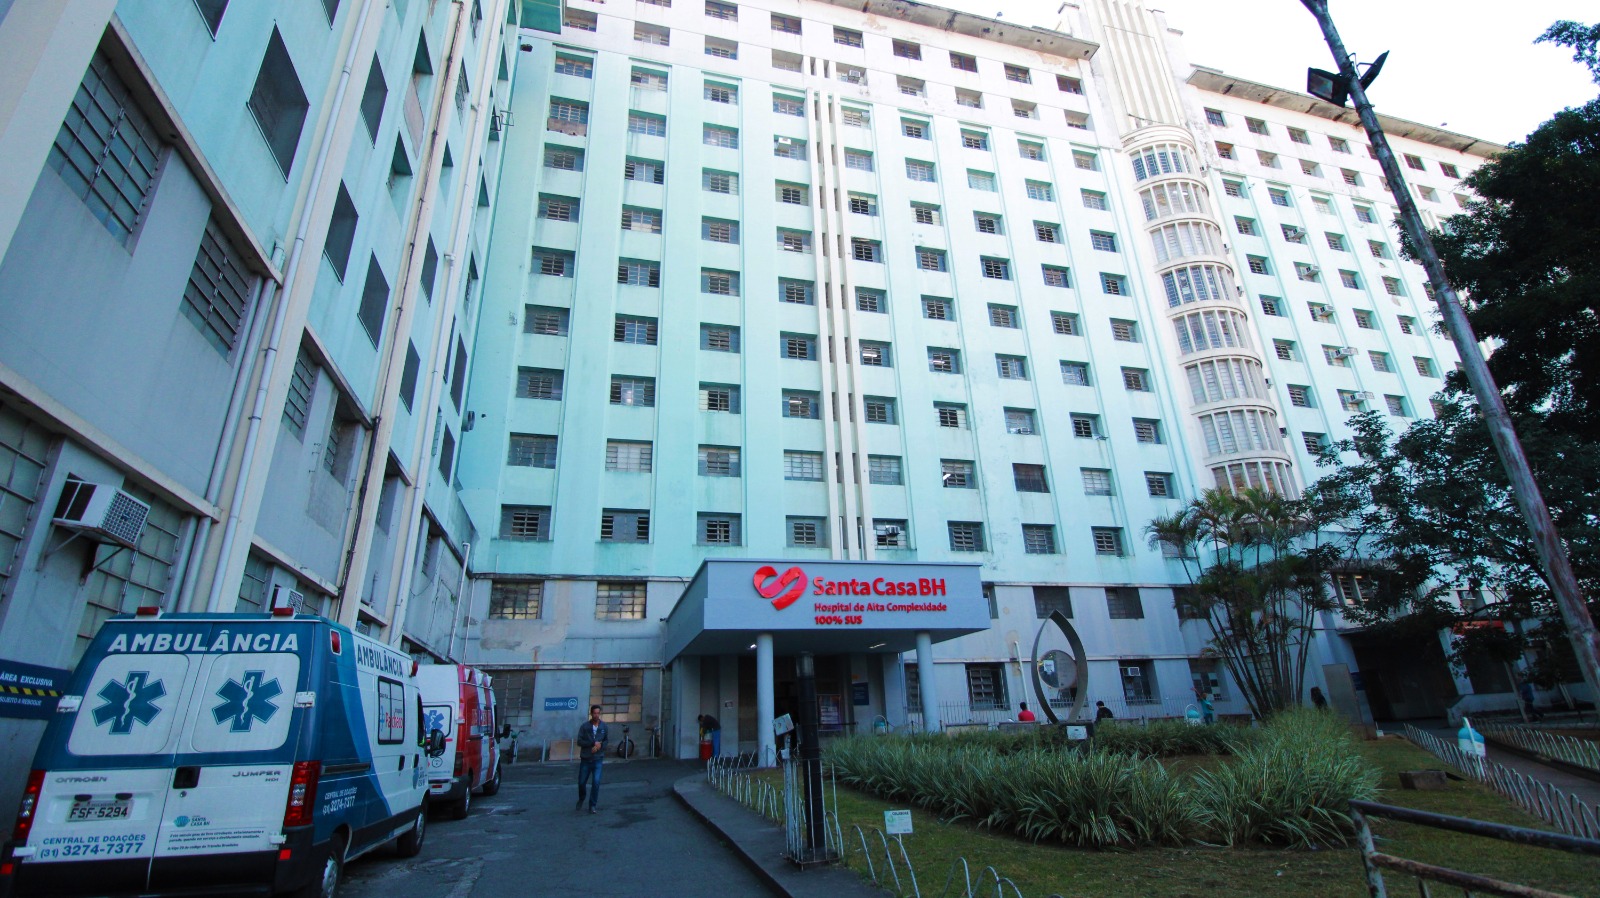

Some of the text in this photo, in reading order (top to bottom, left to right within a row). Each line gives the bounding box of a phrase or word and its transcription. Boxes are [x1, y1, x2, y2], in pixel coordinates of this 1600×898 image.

[814, 603, 947, 613] Hospital de Alta Complexidade
[814, 616, 863, 625] 100% SUS
[107, 630, 299, 652] AMBULÂNCIA
[357, 644, 404, 678] AMBULÂNCIA
[0, 671, 53, 687] ÁREA EXCLUSIVA
[43, 837, 85, 845] CENTRAL
[102, 834, 146, 843] DOAÇÕES
[41, 843, 143, 858] (31) 3274-7377
